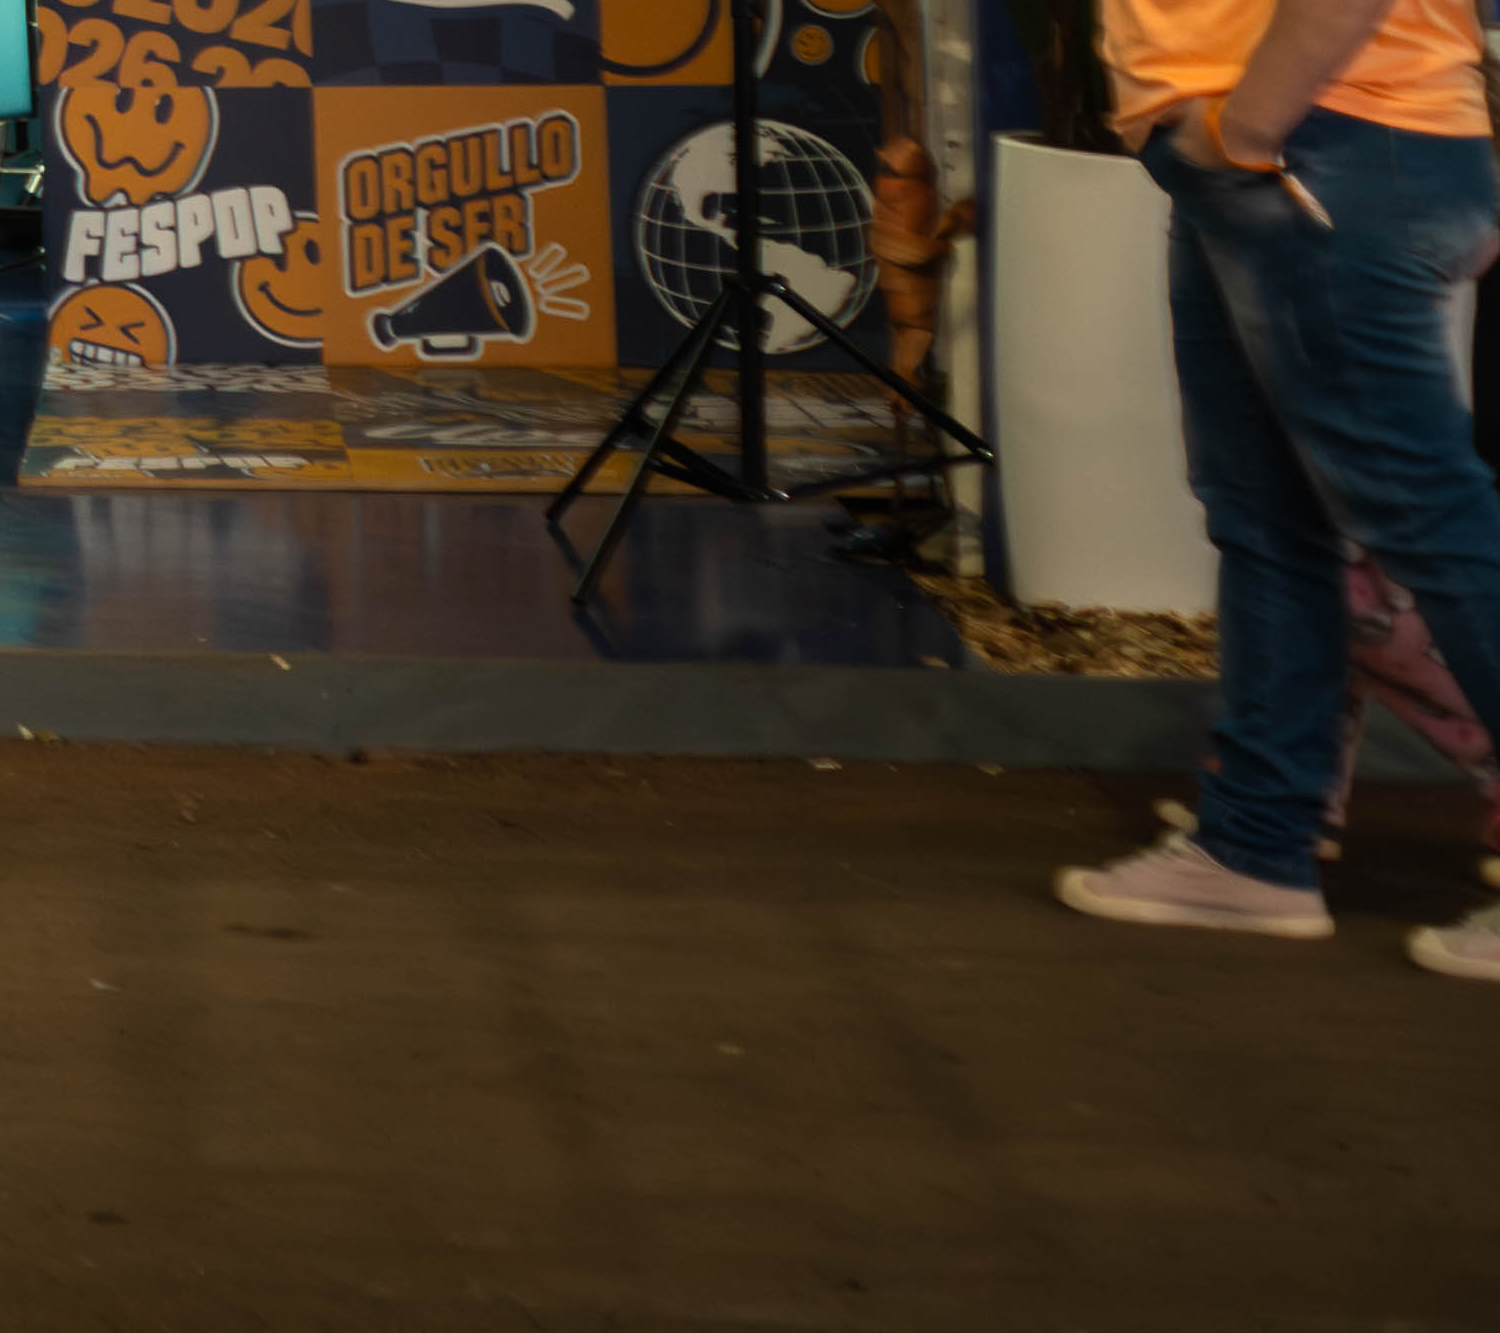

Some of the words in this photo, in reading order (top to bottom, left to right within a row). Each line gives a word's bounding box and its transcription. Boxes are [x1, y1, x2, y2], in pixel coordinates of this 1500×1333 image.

[344, 116, 575, 222] ORGULLO
[61, 183, 295, 284] FESPOP
[350, 214, 421, 291] DE
